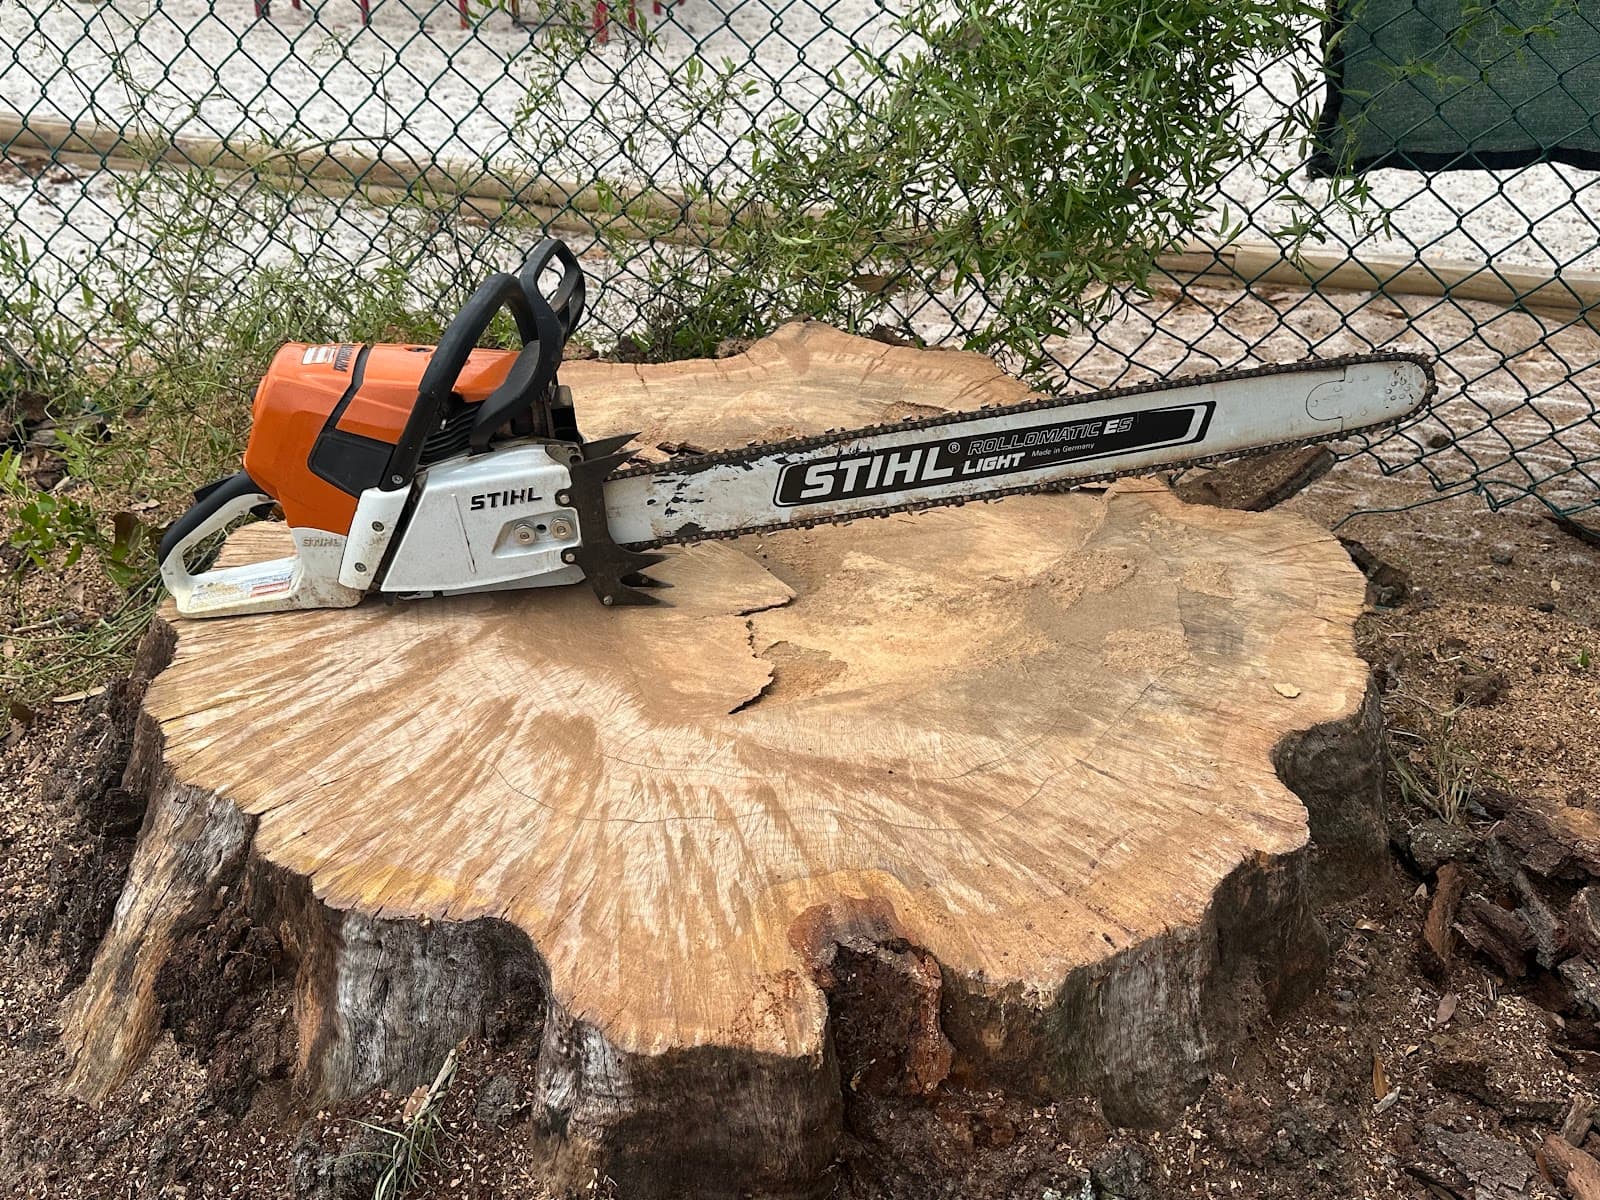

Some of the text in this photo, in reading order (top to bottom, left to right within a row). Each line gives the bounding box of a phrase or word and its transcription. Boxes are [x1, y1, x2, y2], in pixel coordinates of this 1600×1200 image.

[968, 416, 1134, 456] ROLLOMATIC ES
[1031, 448, 1052, 457] Made
[1062, 442, 1095, 453] Germany
[800, 447, 954, 499] STIHL
[962, 452, 1026, 475] LIGHT
[470, 487, 543, 511] STIHL
[303, 537, 342, 547] STIHL
